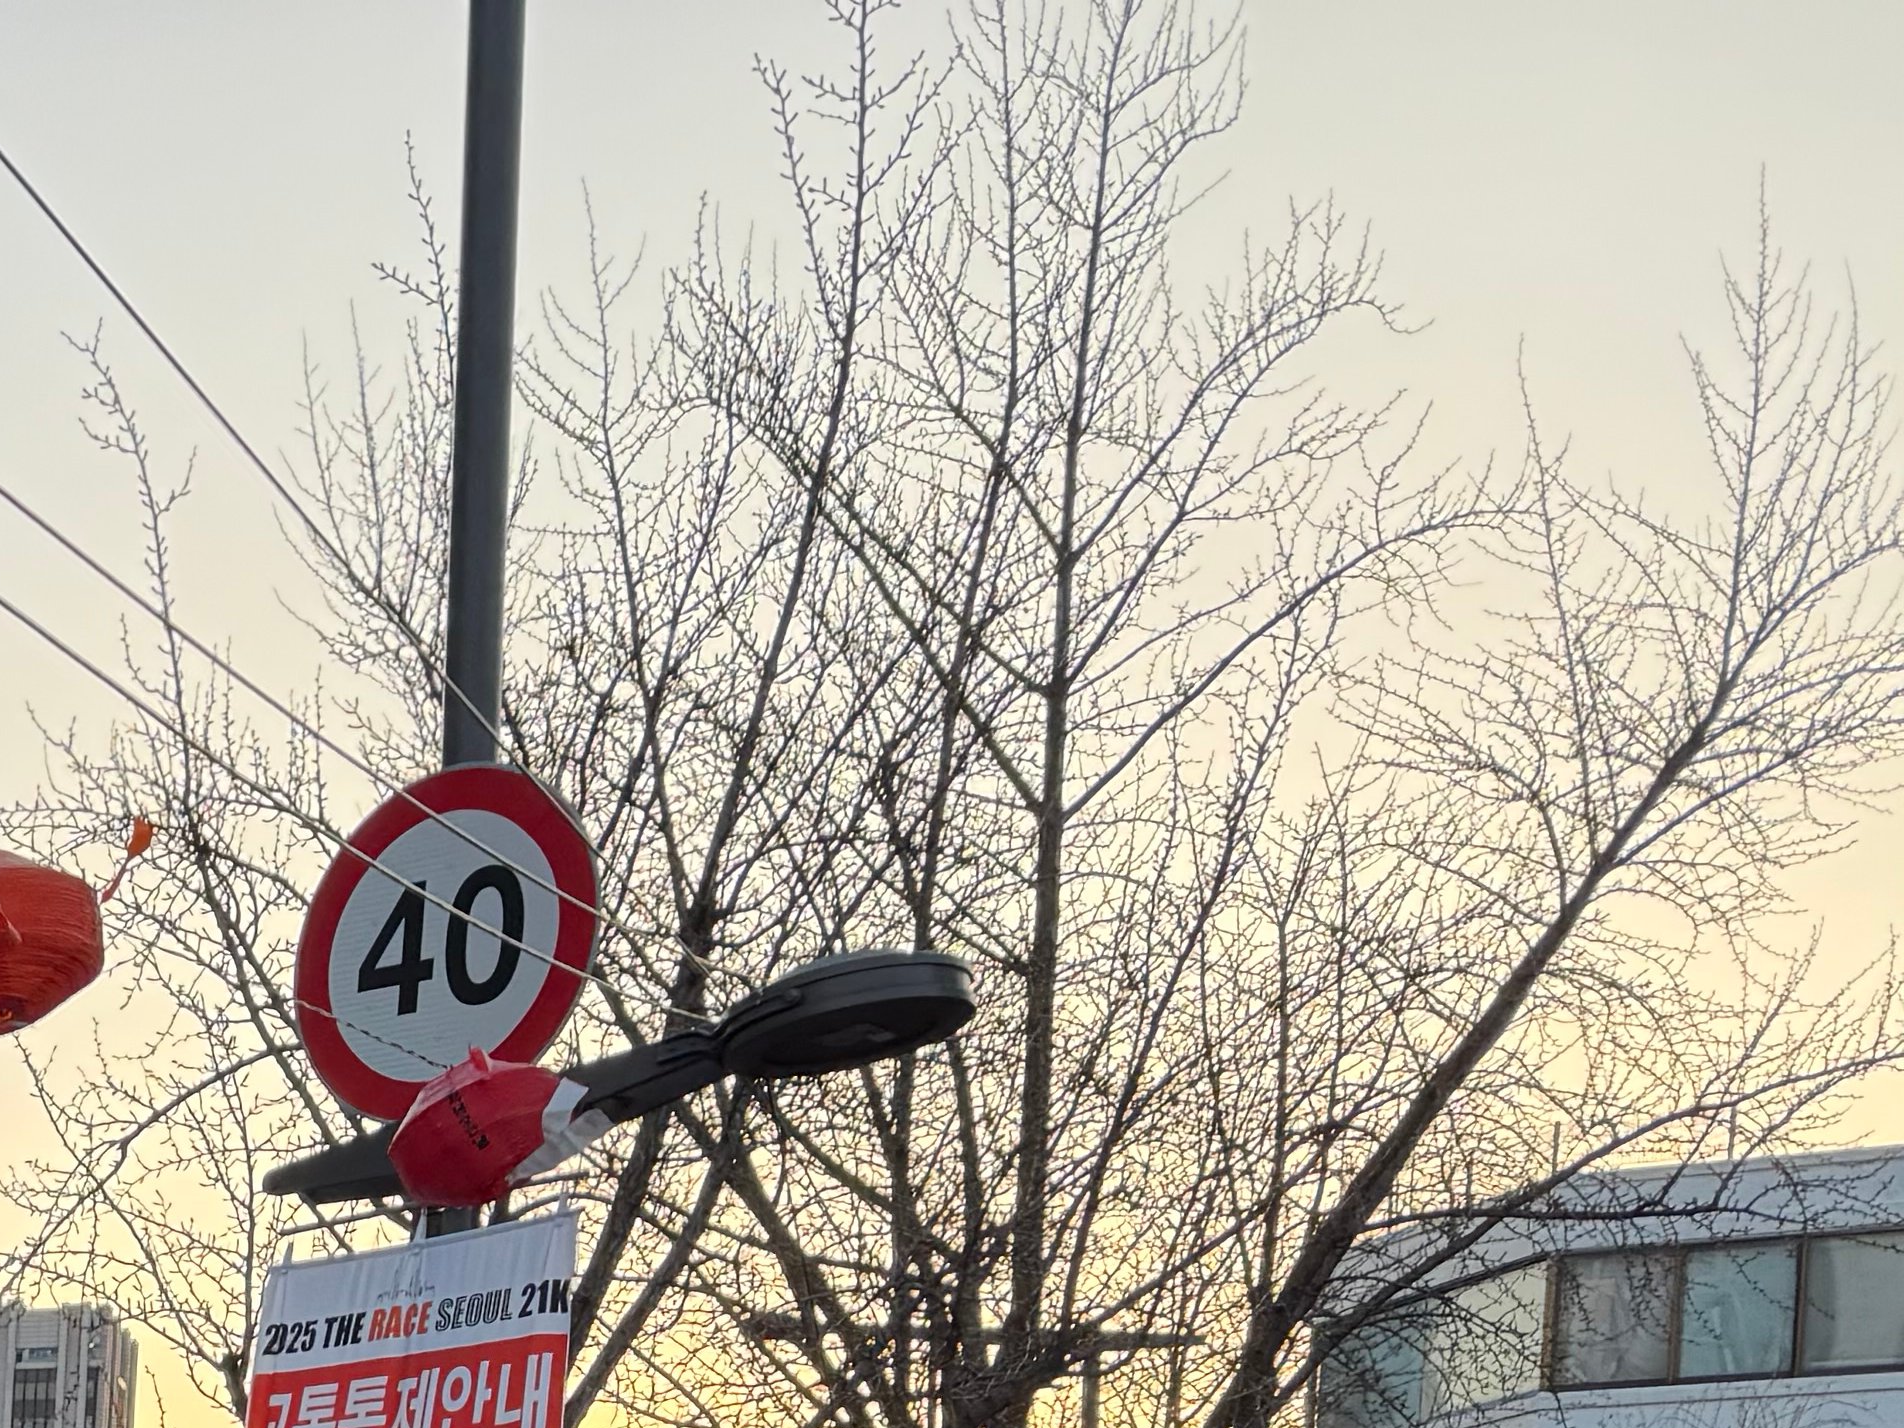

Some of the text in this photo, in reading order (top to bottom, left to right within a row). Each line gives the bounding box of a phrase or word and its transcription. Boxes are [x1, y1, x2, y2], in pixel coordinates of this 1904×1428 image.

[357, 862, 526, 1017] 40
[323, 1313, 363, 1349] THE
[368, 1300, 434, 1341] RACE
[435, 1288, 513, 1332] SEOUL
[519, 1279, 572, 1319] 21K
